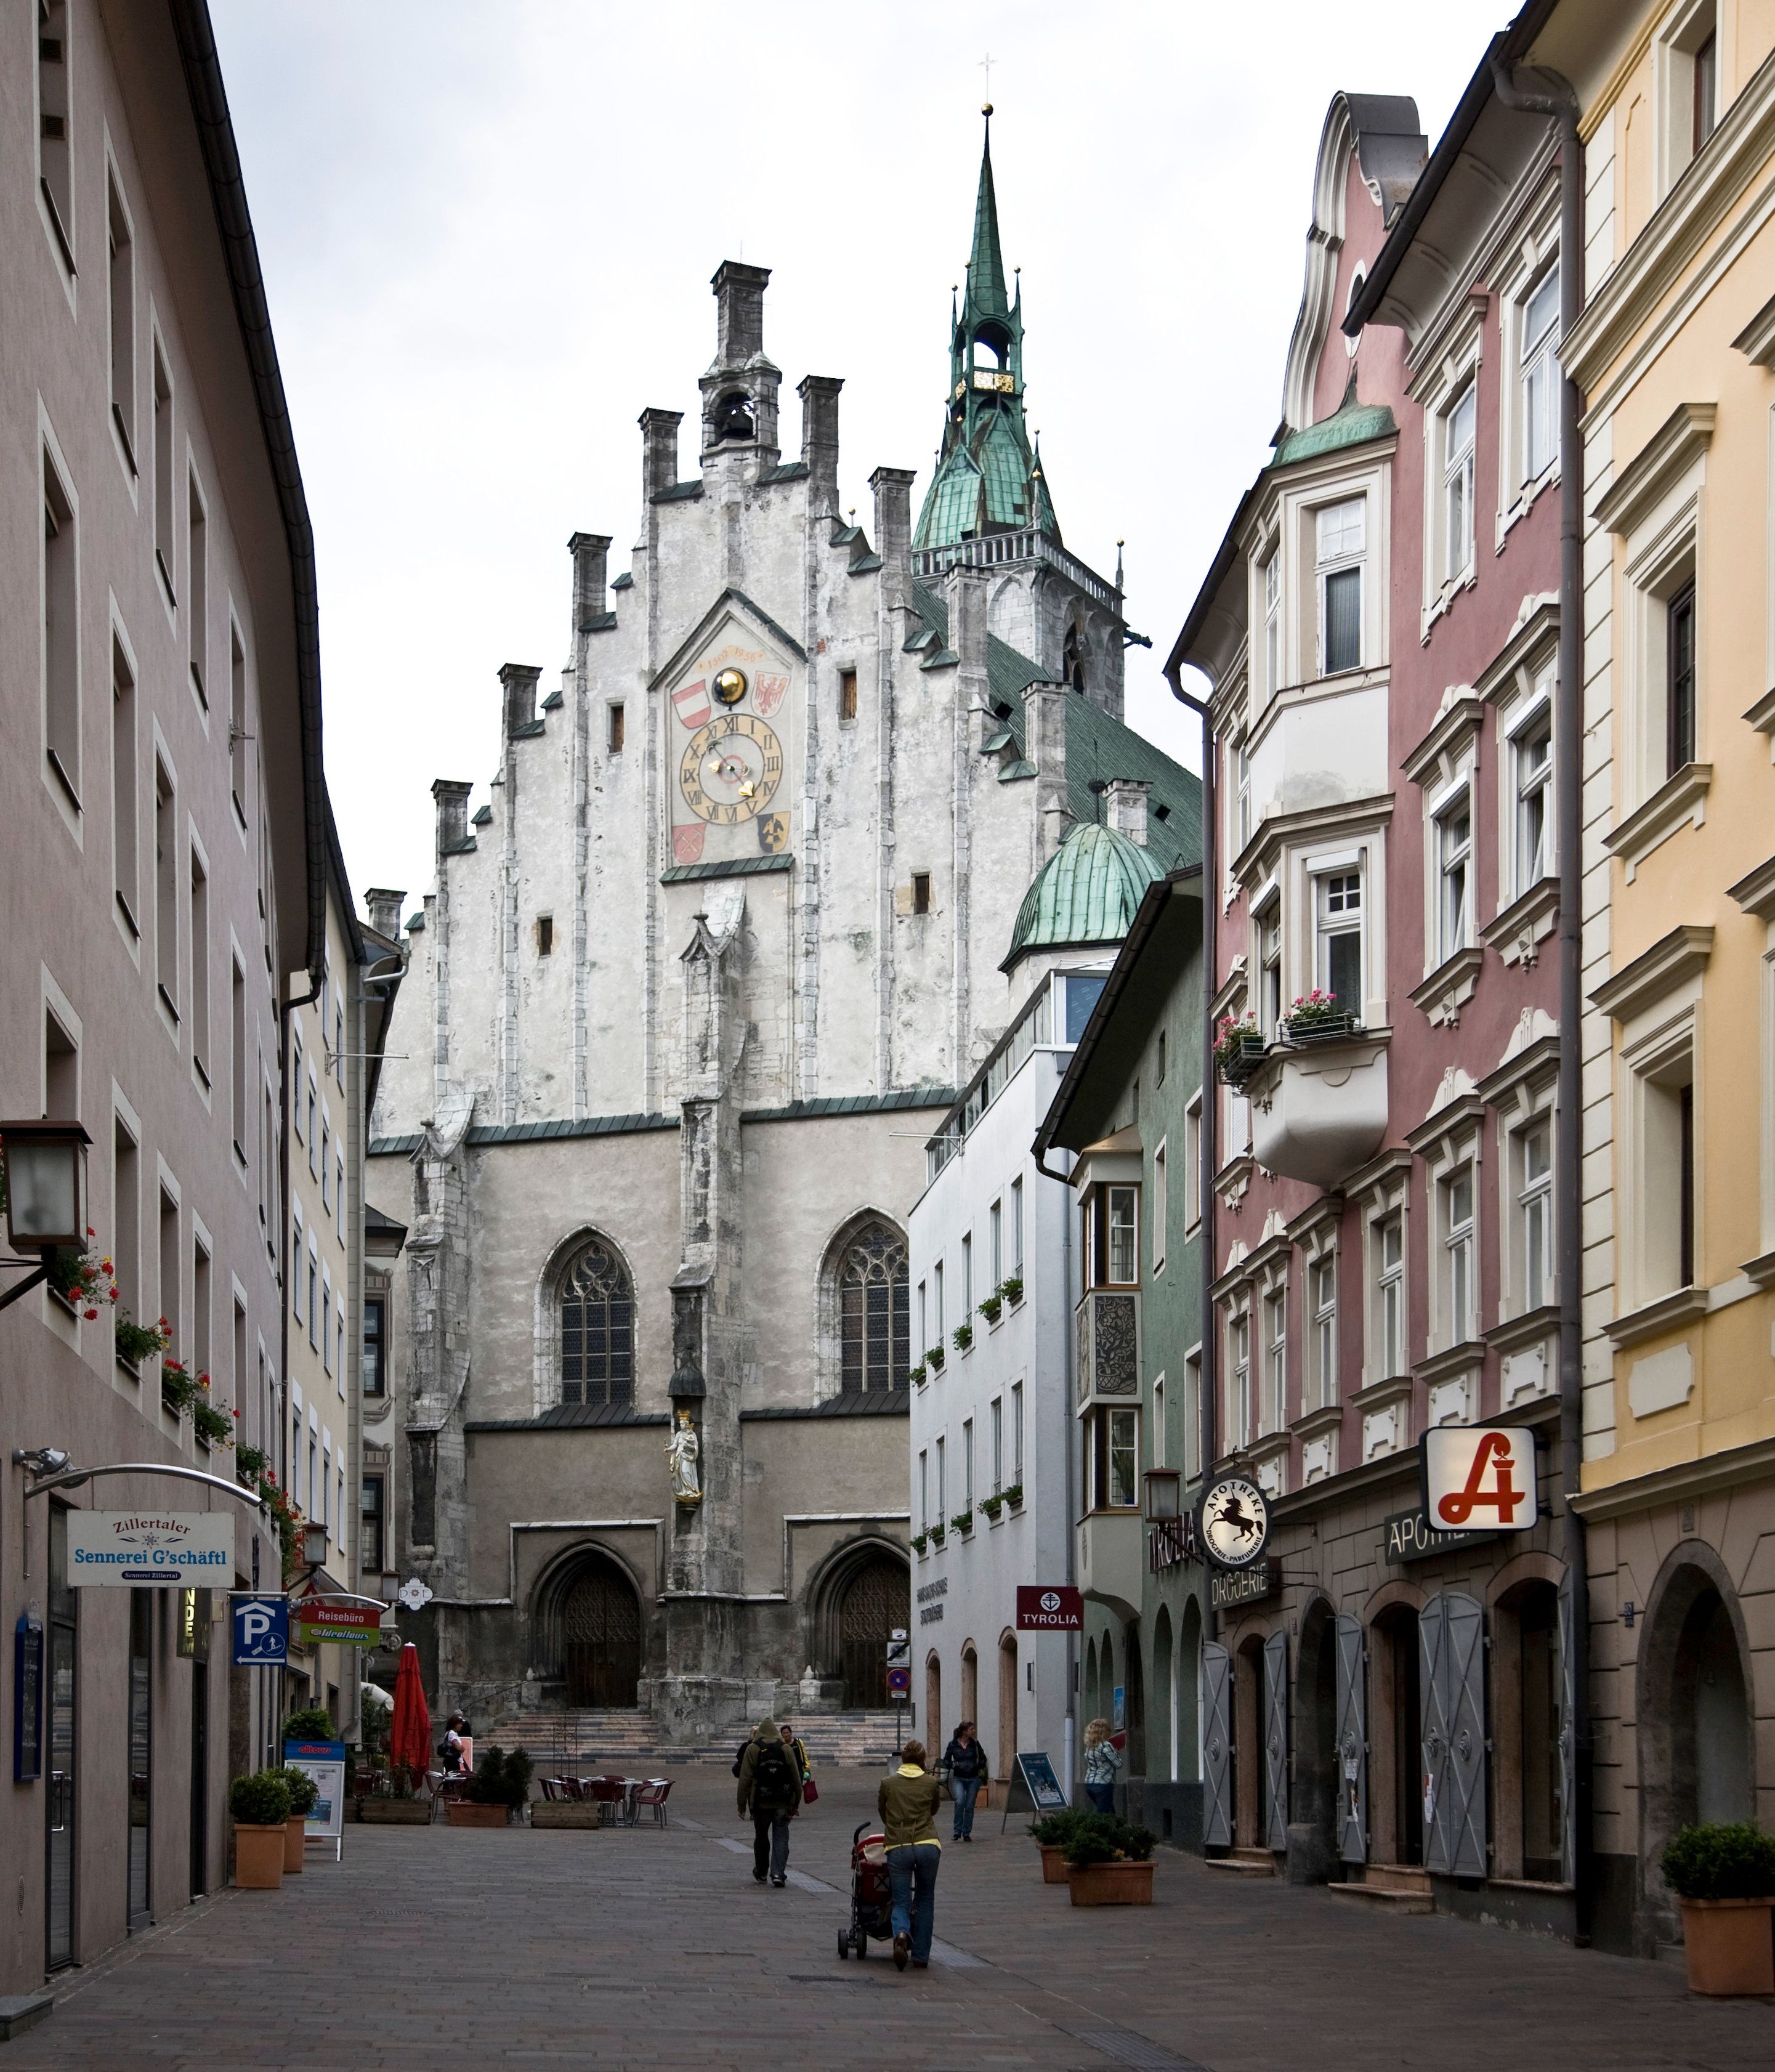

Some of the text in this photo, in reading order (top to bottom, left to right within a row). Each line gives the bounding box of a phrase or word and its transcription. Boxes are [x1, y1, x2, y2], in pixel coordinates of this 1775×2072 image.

[706, 725, 717, 740] XI
[724, 716, 739, 733] XII
[764, 734, 772, 750] II
[690, 744, 701, 760] X
[767, 756, 780, 772] III
[683, 767, 697, 783] IX
[763, 780, 777, 796] IV
[745, 801, 759, 815] V
[1207, 1481, 1263, 1515] APOTHEKE
[113, 1518, 191, 1534] Zillertaler
[1206, 1530, 1226, 1560] DROGERIE
[75, 1548, 227, 1565] Sennerei G'schäftl
[1212, 1562, 1266, 1605] DROGERIE
[318, 1610, 364, 1623] Reisebüro
[1023, 1614, 1079, 1624] TYROLIA
[244, 1614, 270, 1645] P
